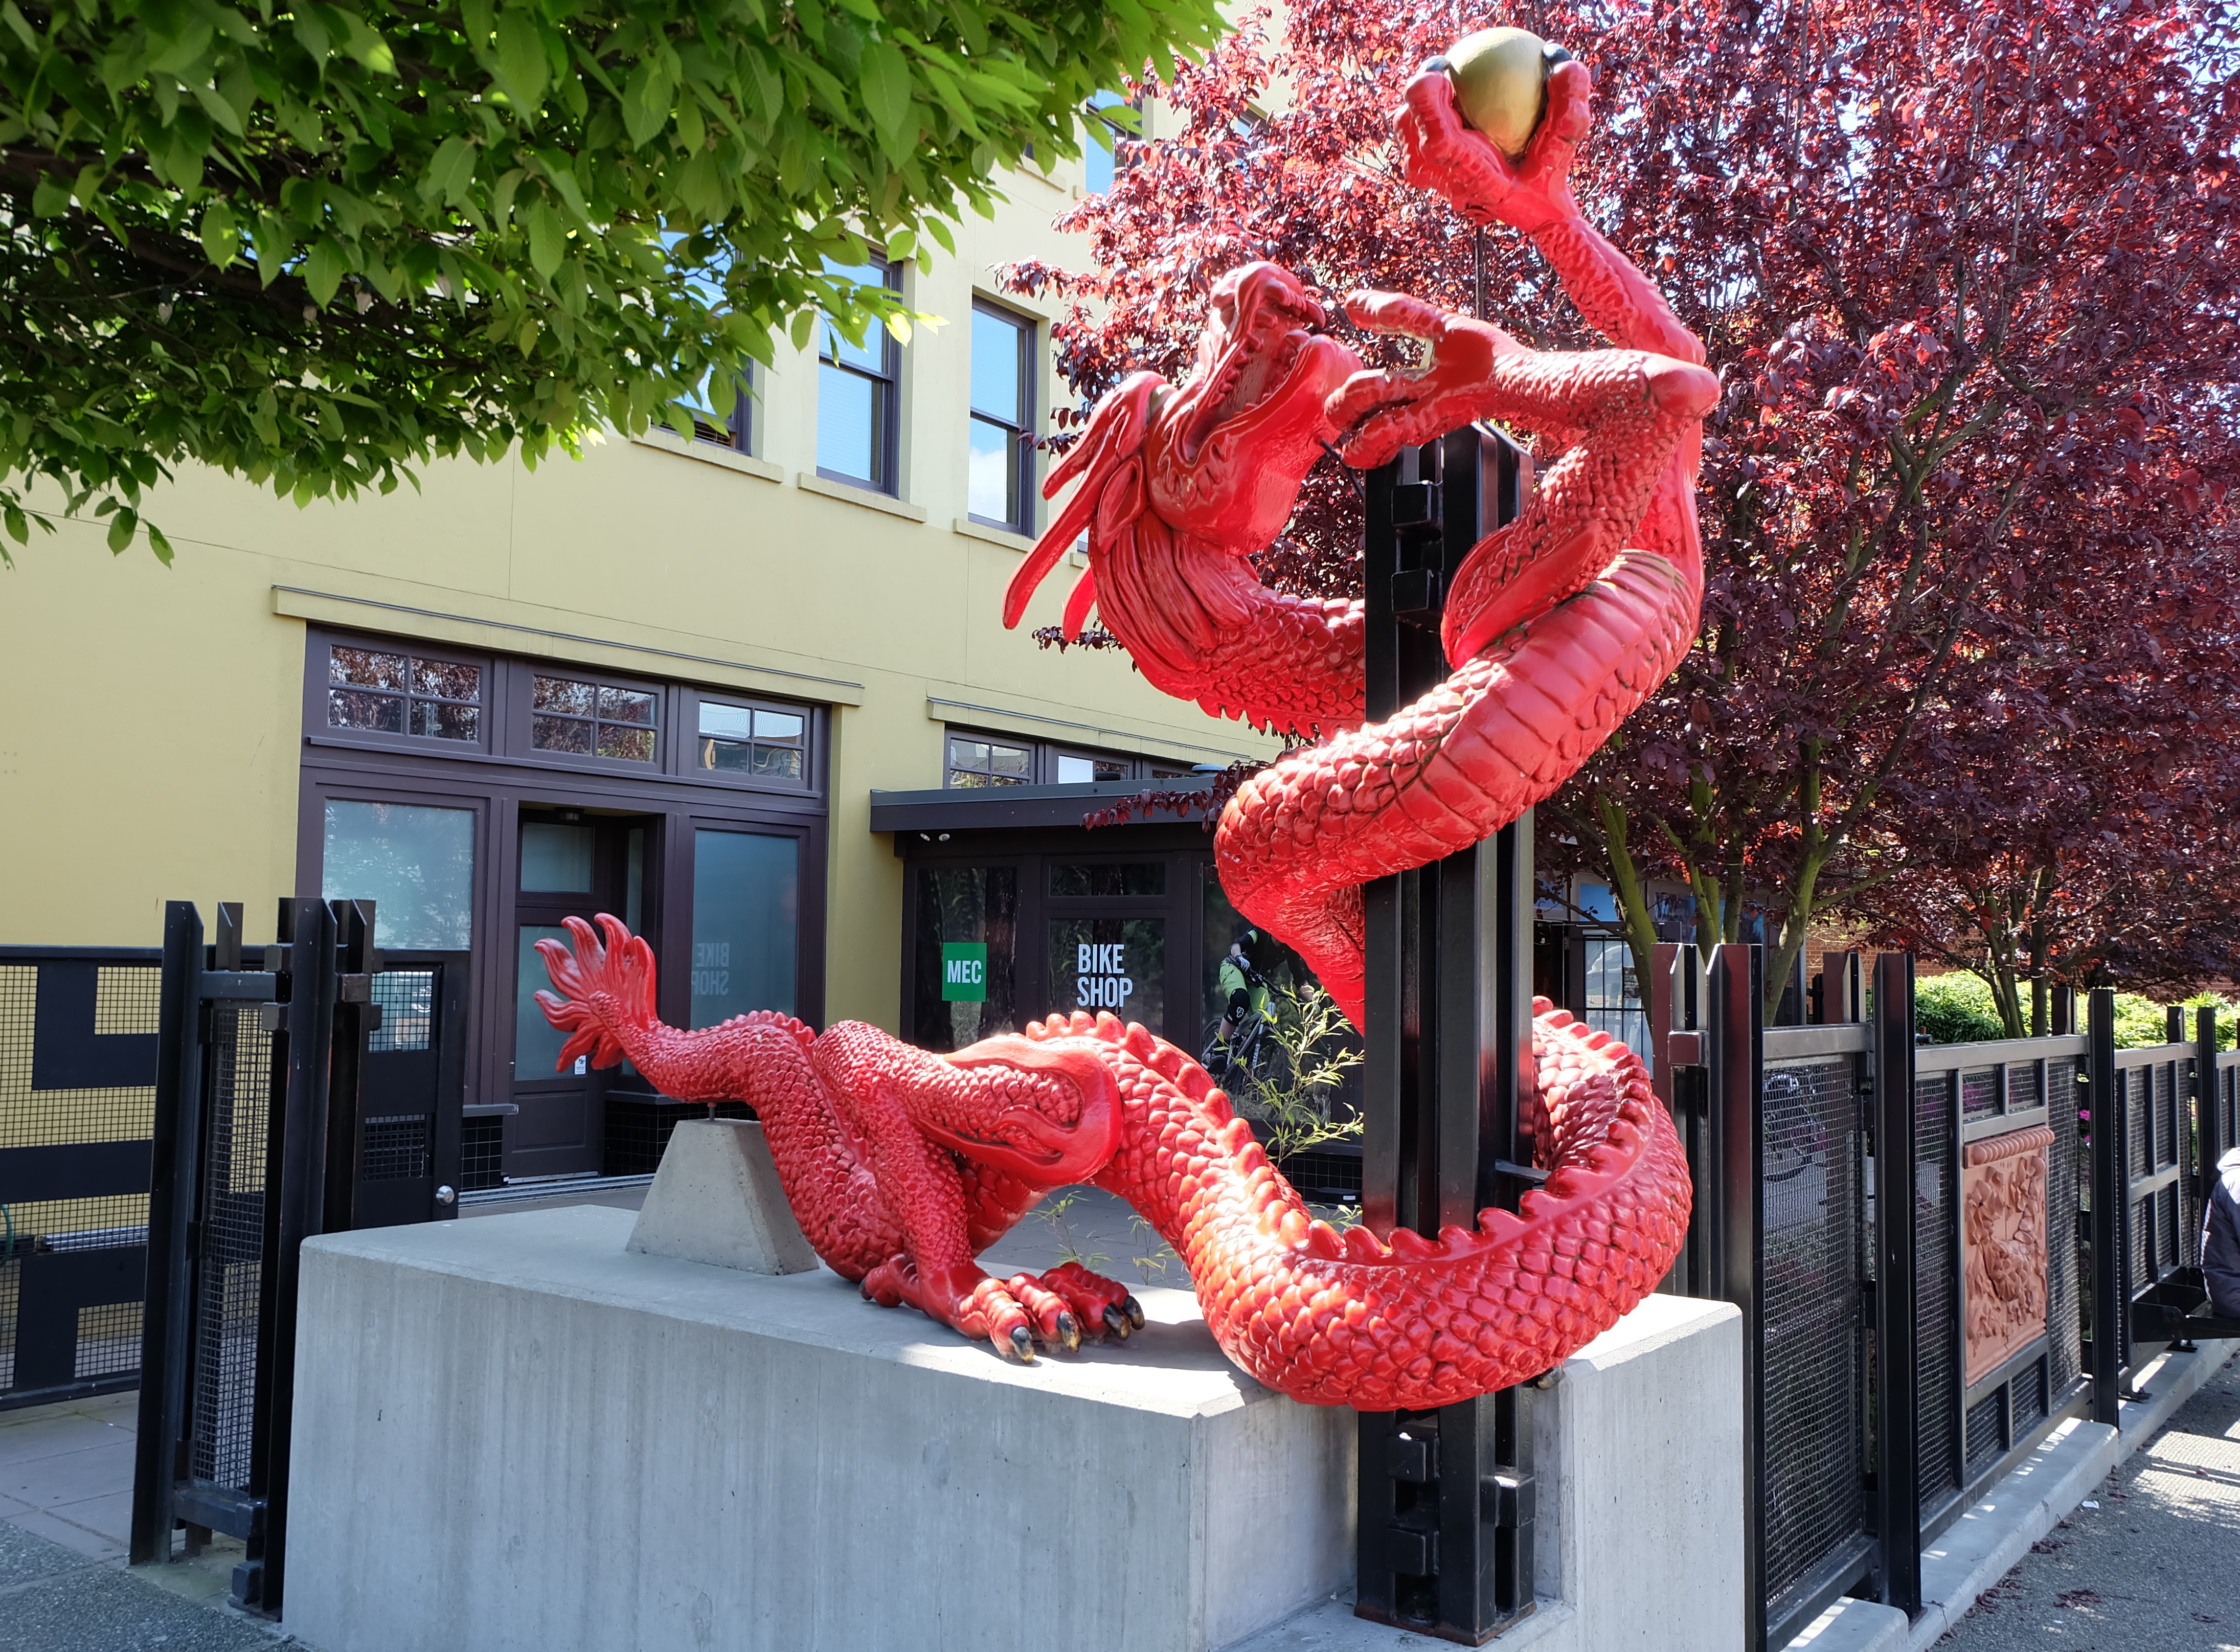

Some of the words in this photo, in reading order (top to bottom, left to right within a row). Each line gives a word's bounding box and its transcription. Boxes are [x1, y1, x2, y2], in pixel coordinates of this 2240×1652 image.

[947, 960, 982, 984] MEC
[1078, 944, 1124, 974] BIKE
[1077, 977, 1133, 1007] SHOP
